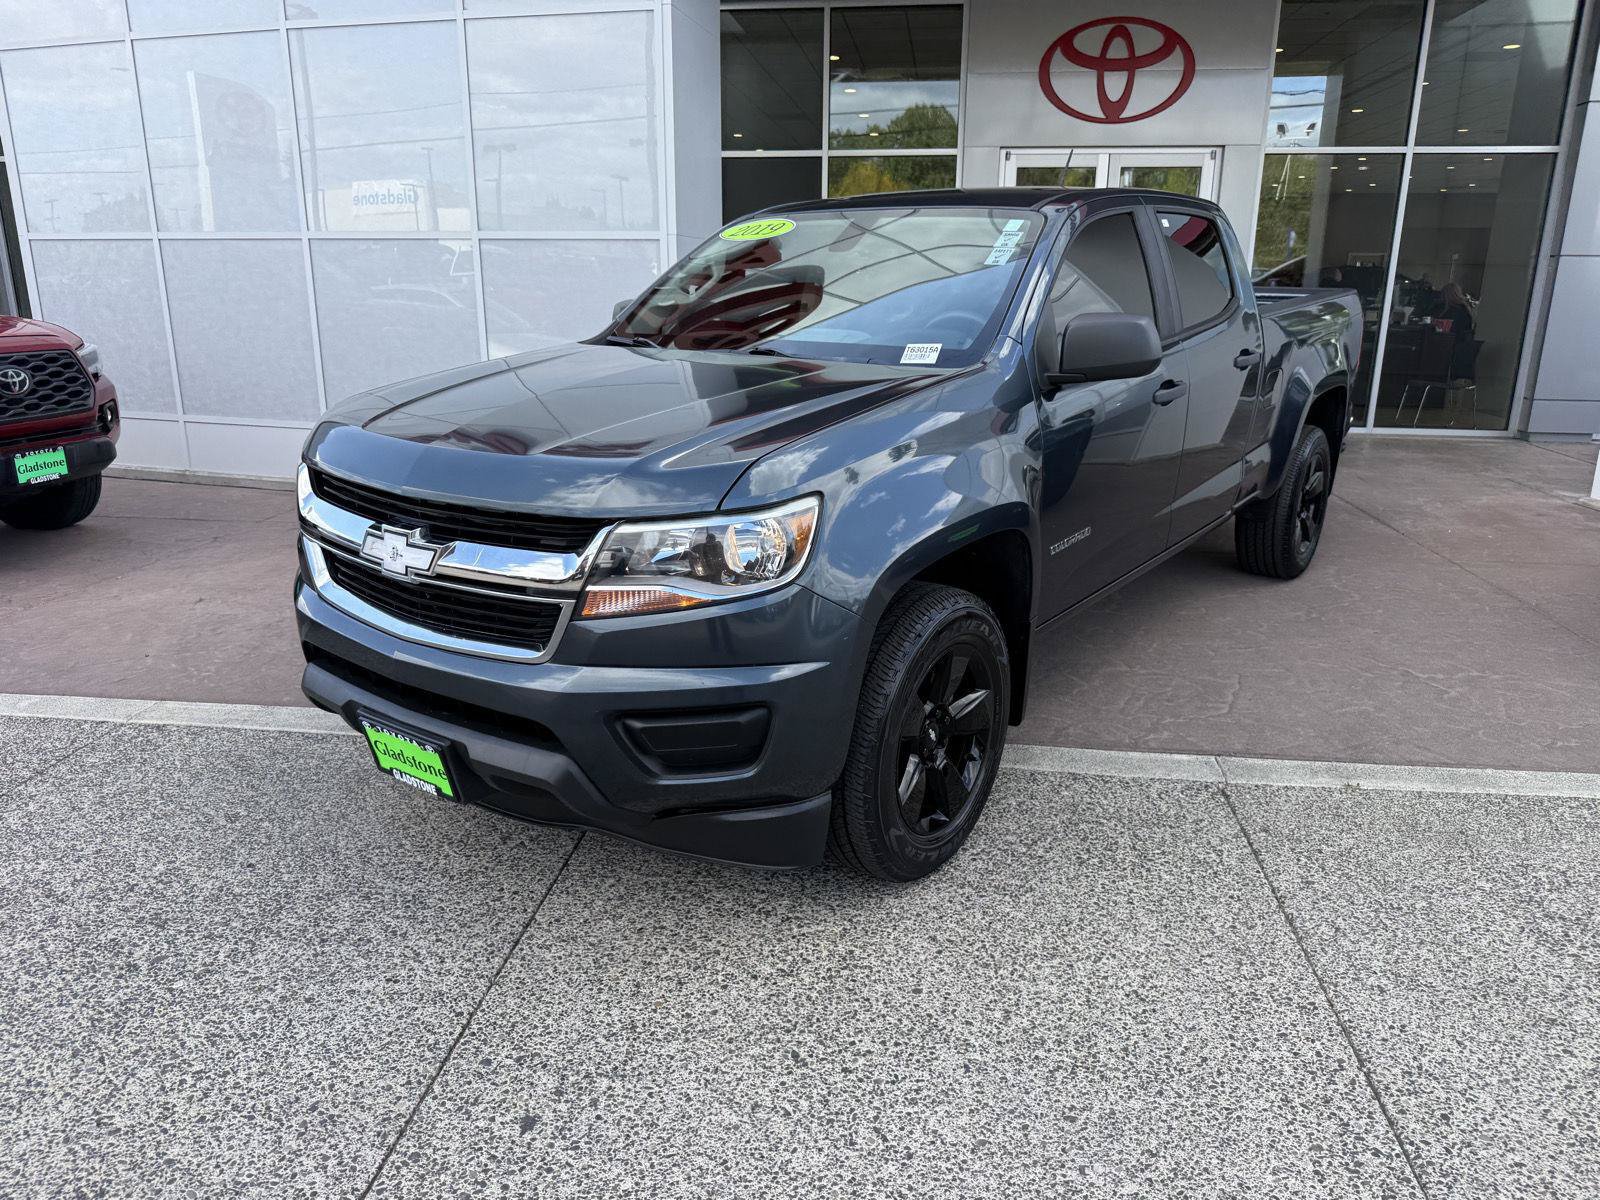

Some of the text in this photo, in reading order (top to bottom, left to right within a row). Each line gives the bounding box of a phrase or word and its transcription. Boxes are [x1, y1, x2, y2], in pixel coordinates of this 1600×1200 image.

[727, 222, 786, 237] 2019
[25, 448, 53, 457] TOYOTA
[17, 459, 65, 475] Gladstone
[30, 473, 60, 485] GLADSTONE
[1050, 526, 1091, 556] COLORADO
[373, 740, 448, 781] Gladstone
[392, 769, 438, 796] GLADSTONE
